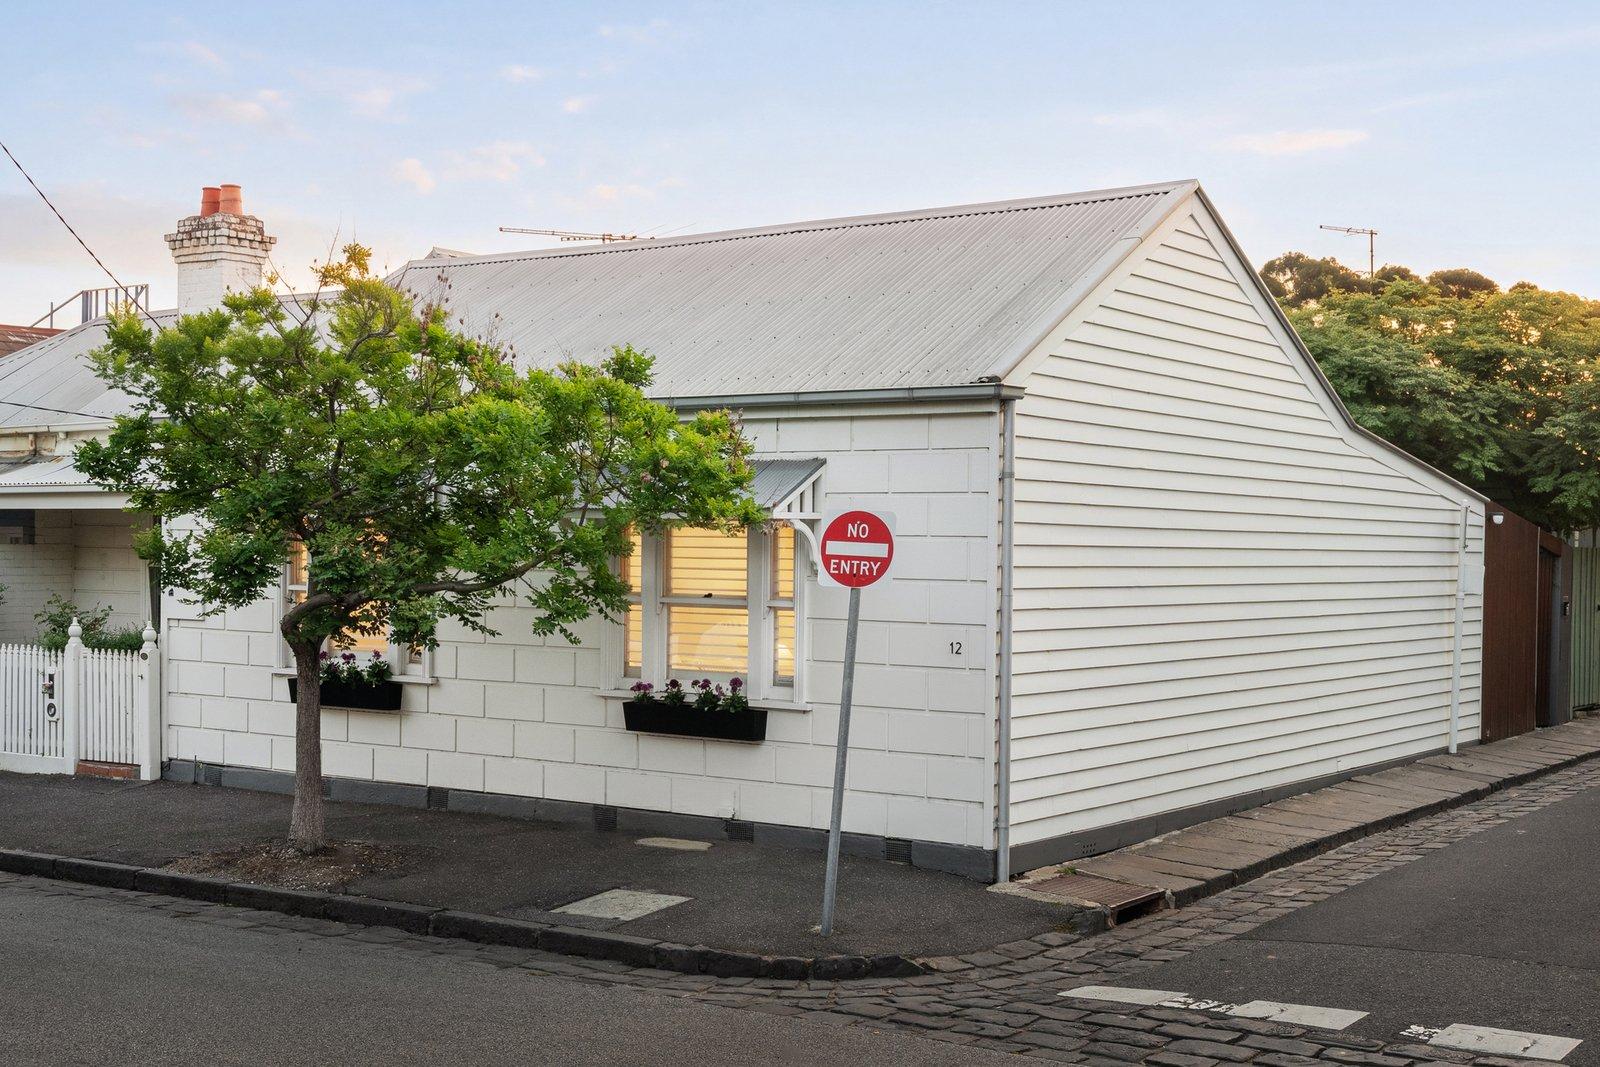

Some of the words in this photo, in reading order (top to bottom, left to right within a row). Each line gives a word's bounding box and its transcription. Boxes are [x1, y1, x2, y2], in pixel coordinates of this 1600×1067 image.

[847, 523, 869, 539] NO
[829, 559, 882, 576] ENTRY
[949, 641, 963, 655] 12
